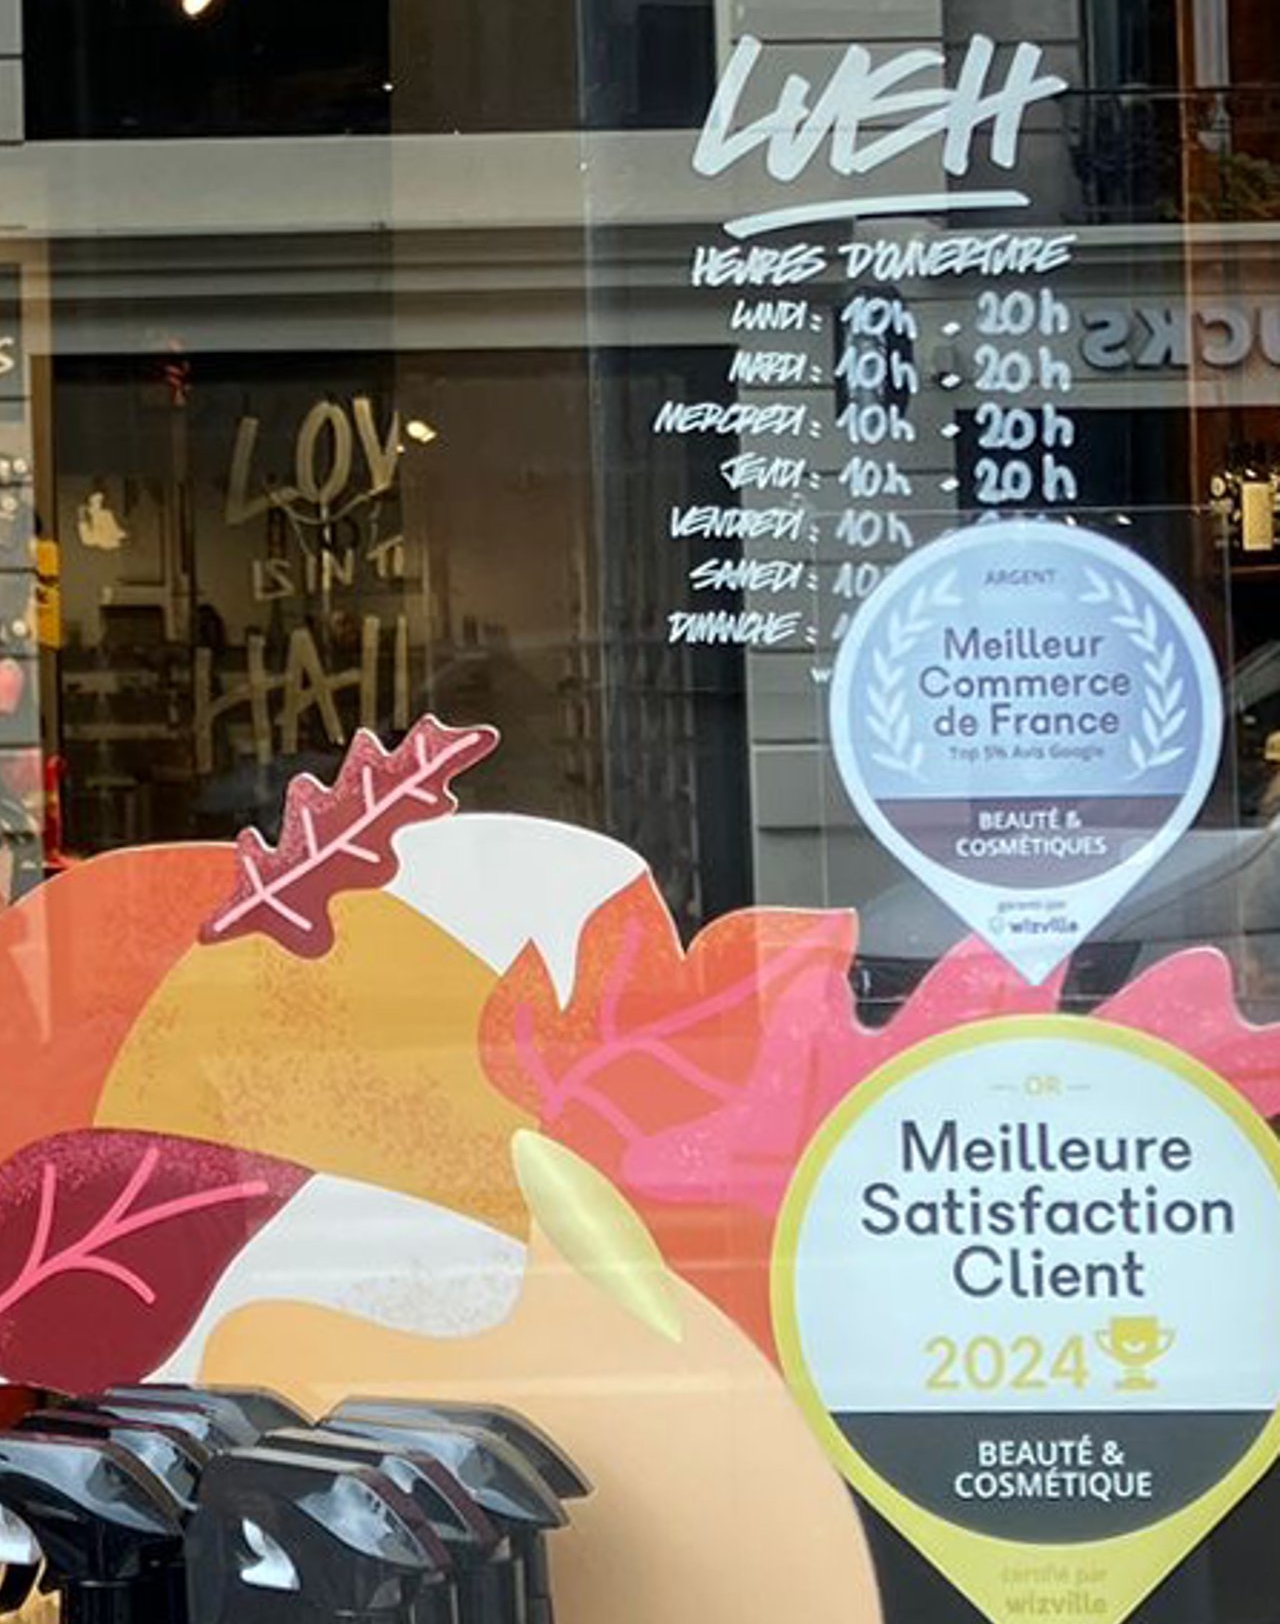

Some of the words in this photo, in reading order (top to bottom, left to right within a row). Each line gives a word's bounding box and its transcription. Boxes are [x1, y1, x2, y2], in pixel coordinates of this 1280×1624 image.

[692, 33, 1067, 182] LUSH
[692, 243, 828, 286] HEURES
[838, 235, 1078, 281] D'OUVERTURE
[984, 568, 1057, 586] ARGENT
[943, 629, 1103, 659] Meilleur
[919, 667, 1130, 698] Commerce
[934, 706, 976, 736] de
[991, 703, 1119, 736] France
[978, 808, 1060, 831] BEAUTÉ
[1066, 812, 1082, 829] &
[956, 833, 1107, 858] COSMÉTIQUES
[899, 1119, 1193, 1173] Meilleure
[861, 1181, 1234, 1236] Satisfaction
[952, 1246, 1144, 1298] Client
[924, 1335, 1089, 1391] 2024
[979, 1434, 1093, 1466] BEAUTÉ
[1102, 1442, 1124, 1466] &
[954, 1466, 1151, 1500] COSMÉTIQUE
